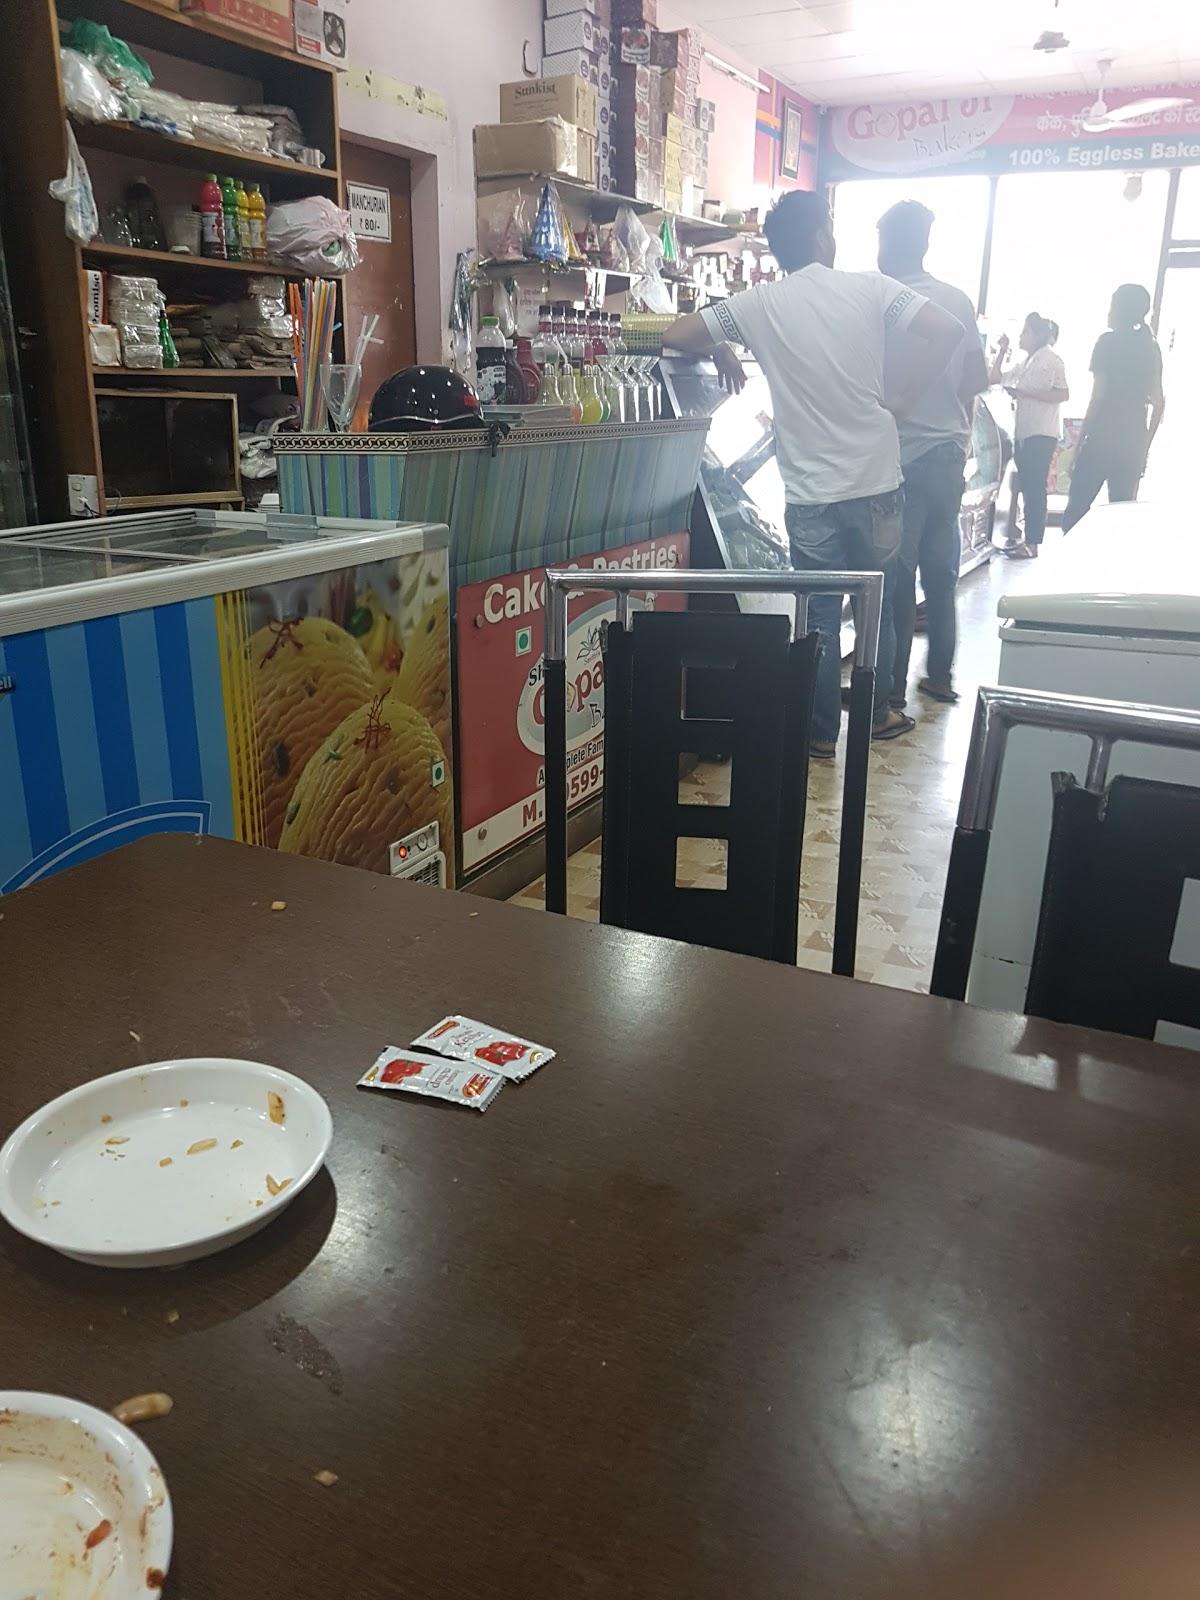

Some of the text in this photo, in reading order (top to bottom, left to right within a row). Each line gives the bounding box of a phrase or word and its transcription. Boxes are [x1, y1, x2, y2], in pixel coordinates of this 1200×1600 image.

[514, 81, 556, 99] Sunkist
[1009, 148, 1060, 167] 100%
[1067, 143, 1144, 165] Eggless
